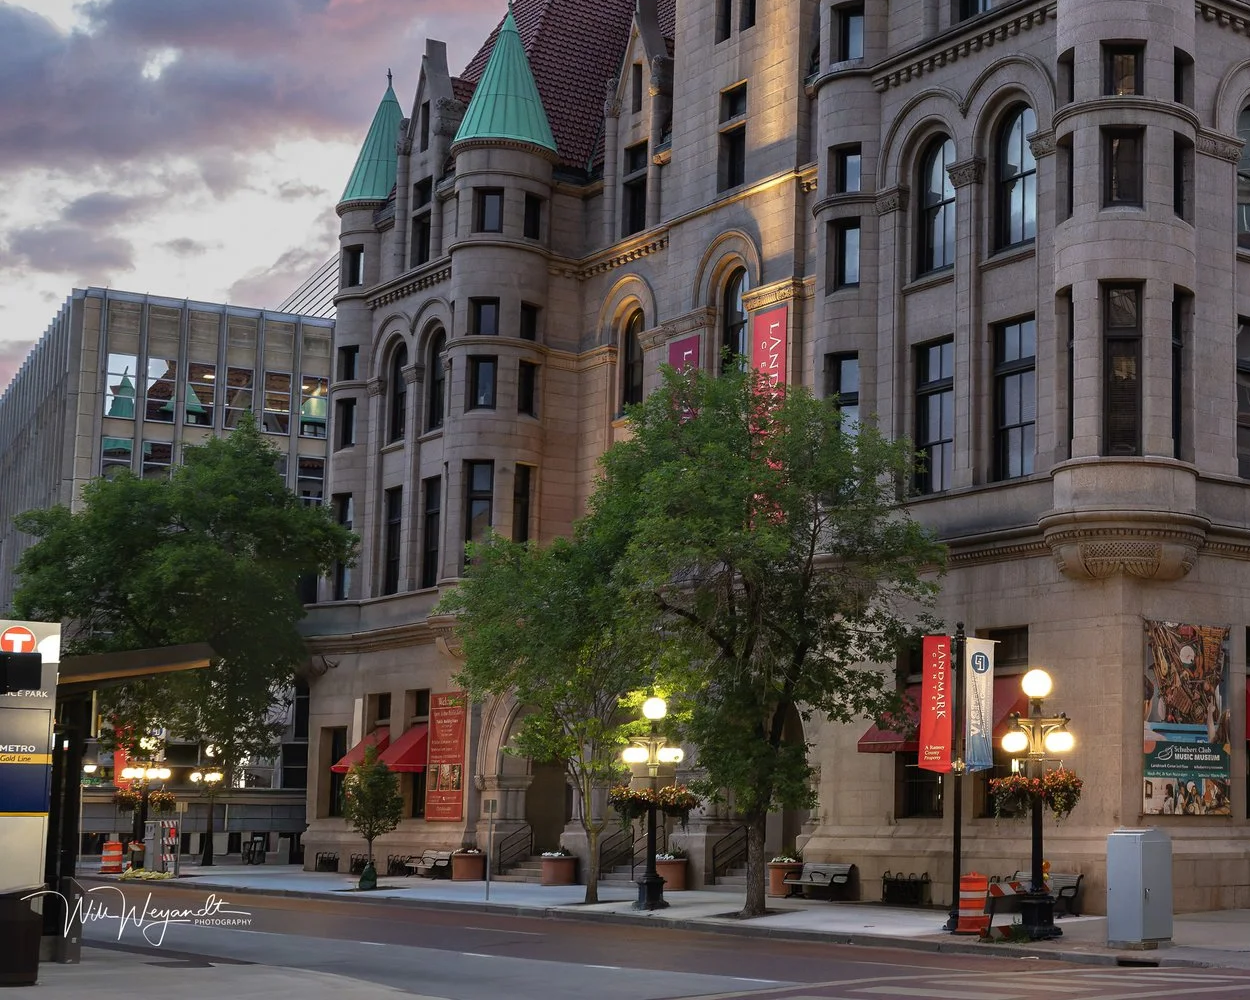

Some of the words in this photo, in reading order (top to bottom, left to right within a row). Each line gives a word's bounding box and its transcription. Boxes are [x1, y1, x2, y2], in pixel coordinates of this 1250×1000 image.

[937, 644, 946, 719] LANDMARK
[25, 690, 48, 698] PARK
[0, 744, 36, 753] METRO
[0, 754, 16, 762] Gold
[1195, 753, 1220, 761] MUSEUM
